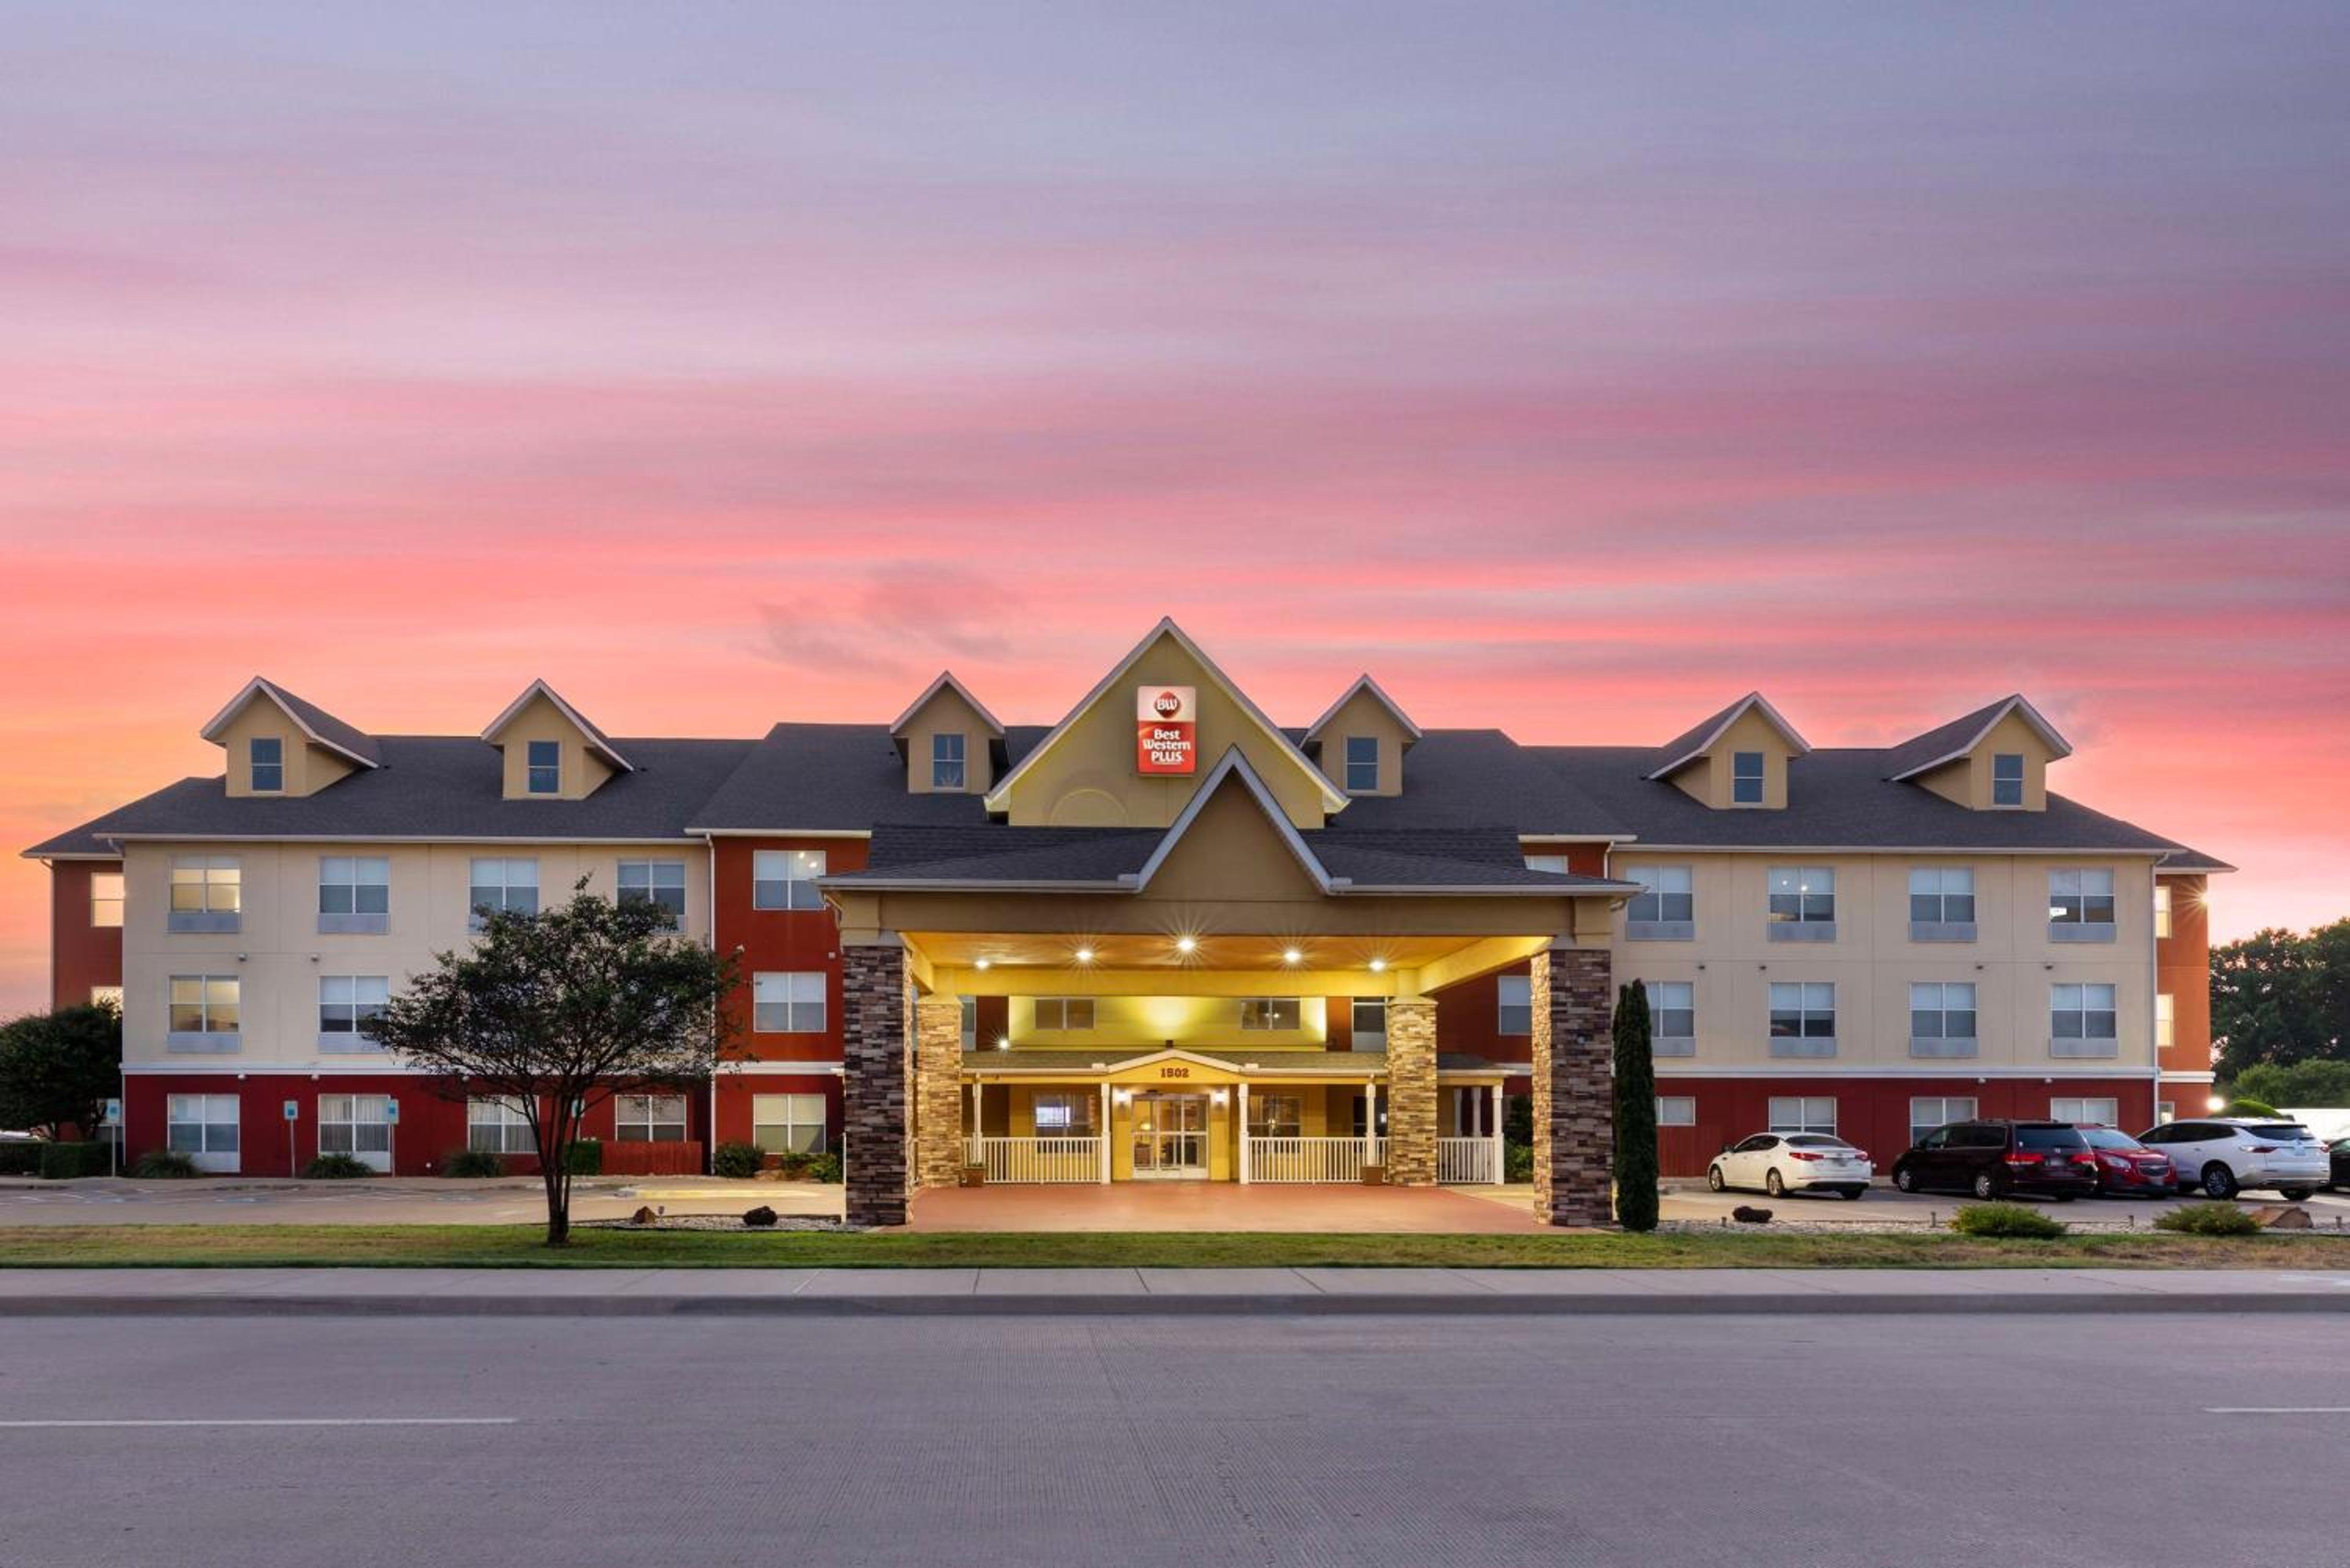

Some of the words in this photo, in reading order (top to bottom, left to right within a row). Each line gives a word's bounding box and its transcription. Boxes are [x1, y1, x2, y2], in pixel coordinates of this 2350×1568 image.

[1157, 698, 1177, 710] BW
[1154, 729, 1180, 740] Best
[1143, 739, 1191, 750] Western
[1152, 751, 1183, 762] PLUS
